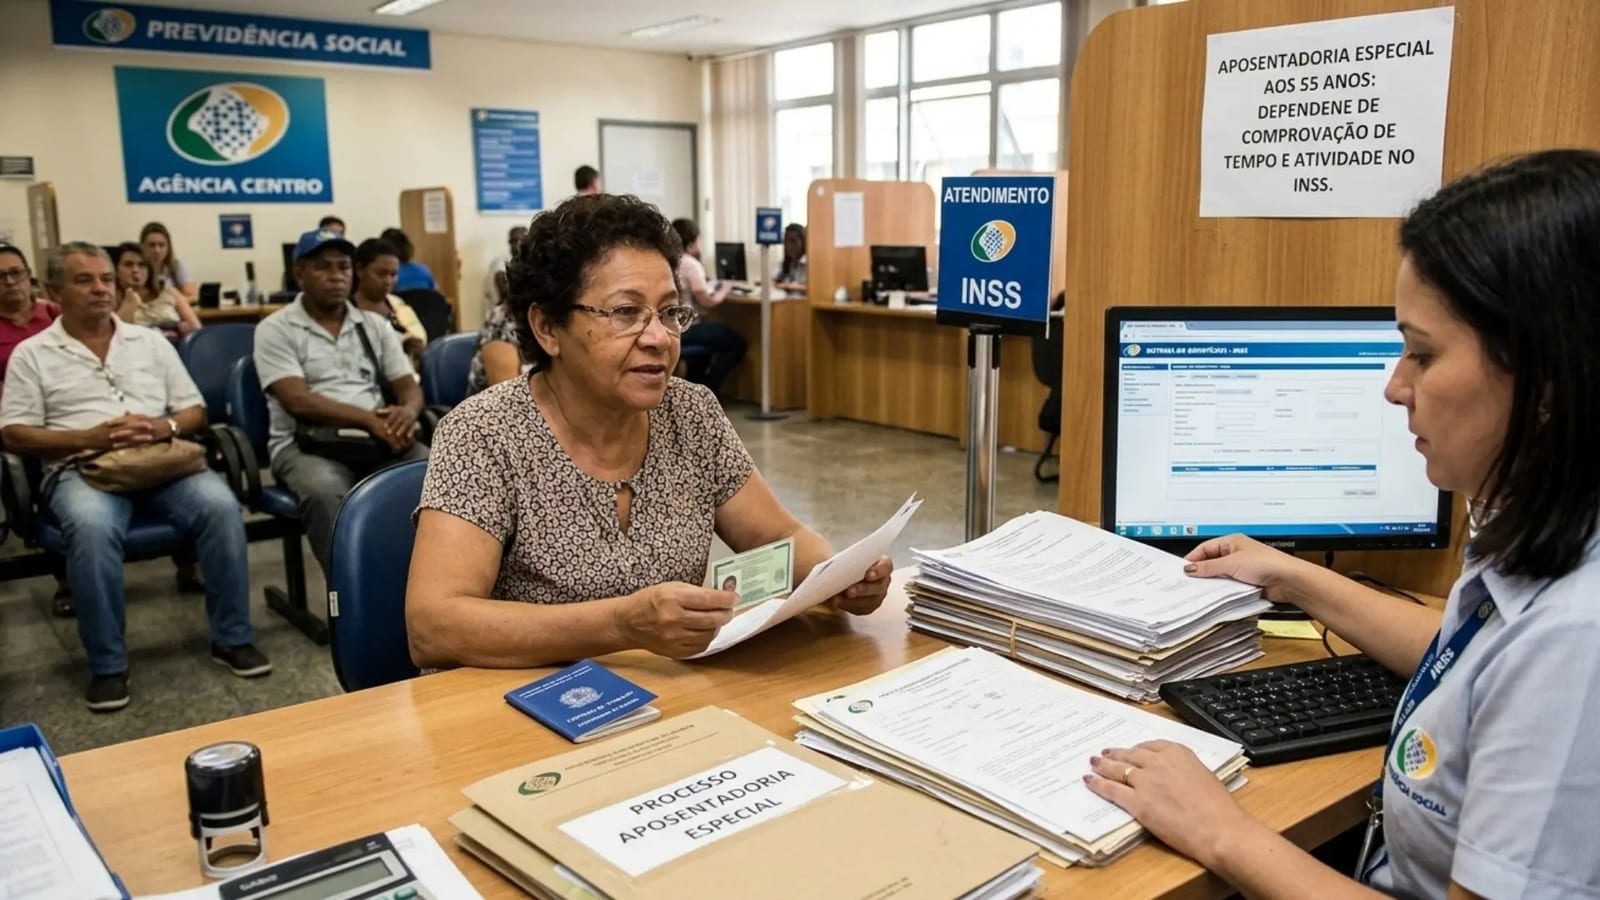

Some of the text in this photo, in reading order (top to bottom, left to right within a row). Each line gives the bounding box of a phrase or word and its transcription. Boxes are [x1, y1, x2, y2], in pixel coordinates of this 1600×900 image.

[147, 20, 407, 57] PREVIDÊNCIA SOCIAL
[1218, 40, 1434, 74] APOSENTADORIA ESPECIAL
[1264, 72, 1376, 94] AOS 55 ANOS:
[1258, 98, 1380, 119] DEPENDENE DE
[1241, 122, 1396, 144] COMPROVAÇÃO DE
[1224, 149, 1415, 169] TEMPO E ATIVIDADE NO
[138, 172, 323, 195] AGÊNCIA CENTRO
[1293, 177, 1333, 192] INSS.
[944, 186, 1049, 205] ATENDIMENTO
[961, 277, 1022, 309] INSS
[629, 769, 738, 816] PROCESSO
[618, 769, 796, 845] APOSENTADORIA
[684, 796, 783, 841] ESPECIAL
